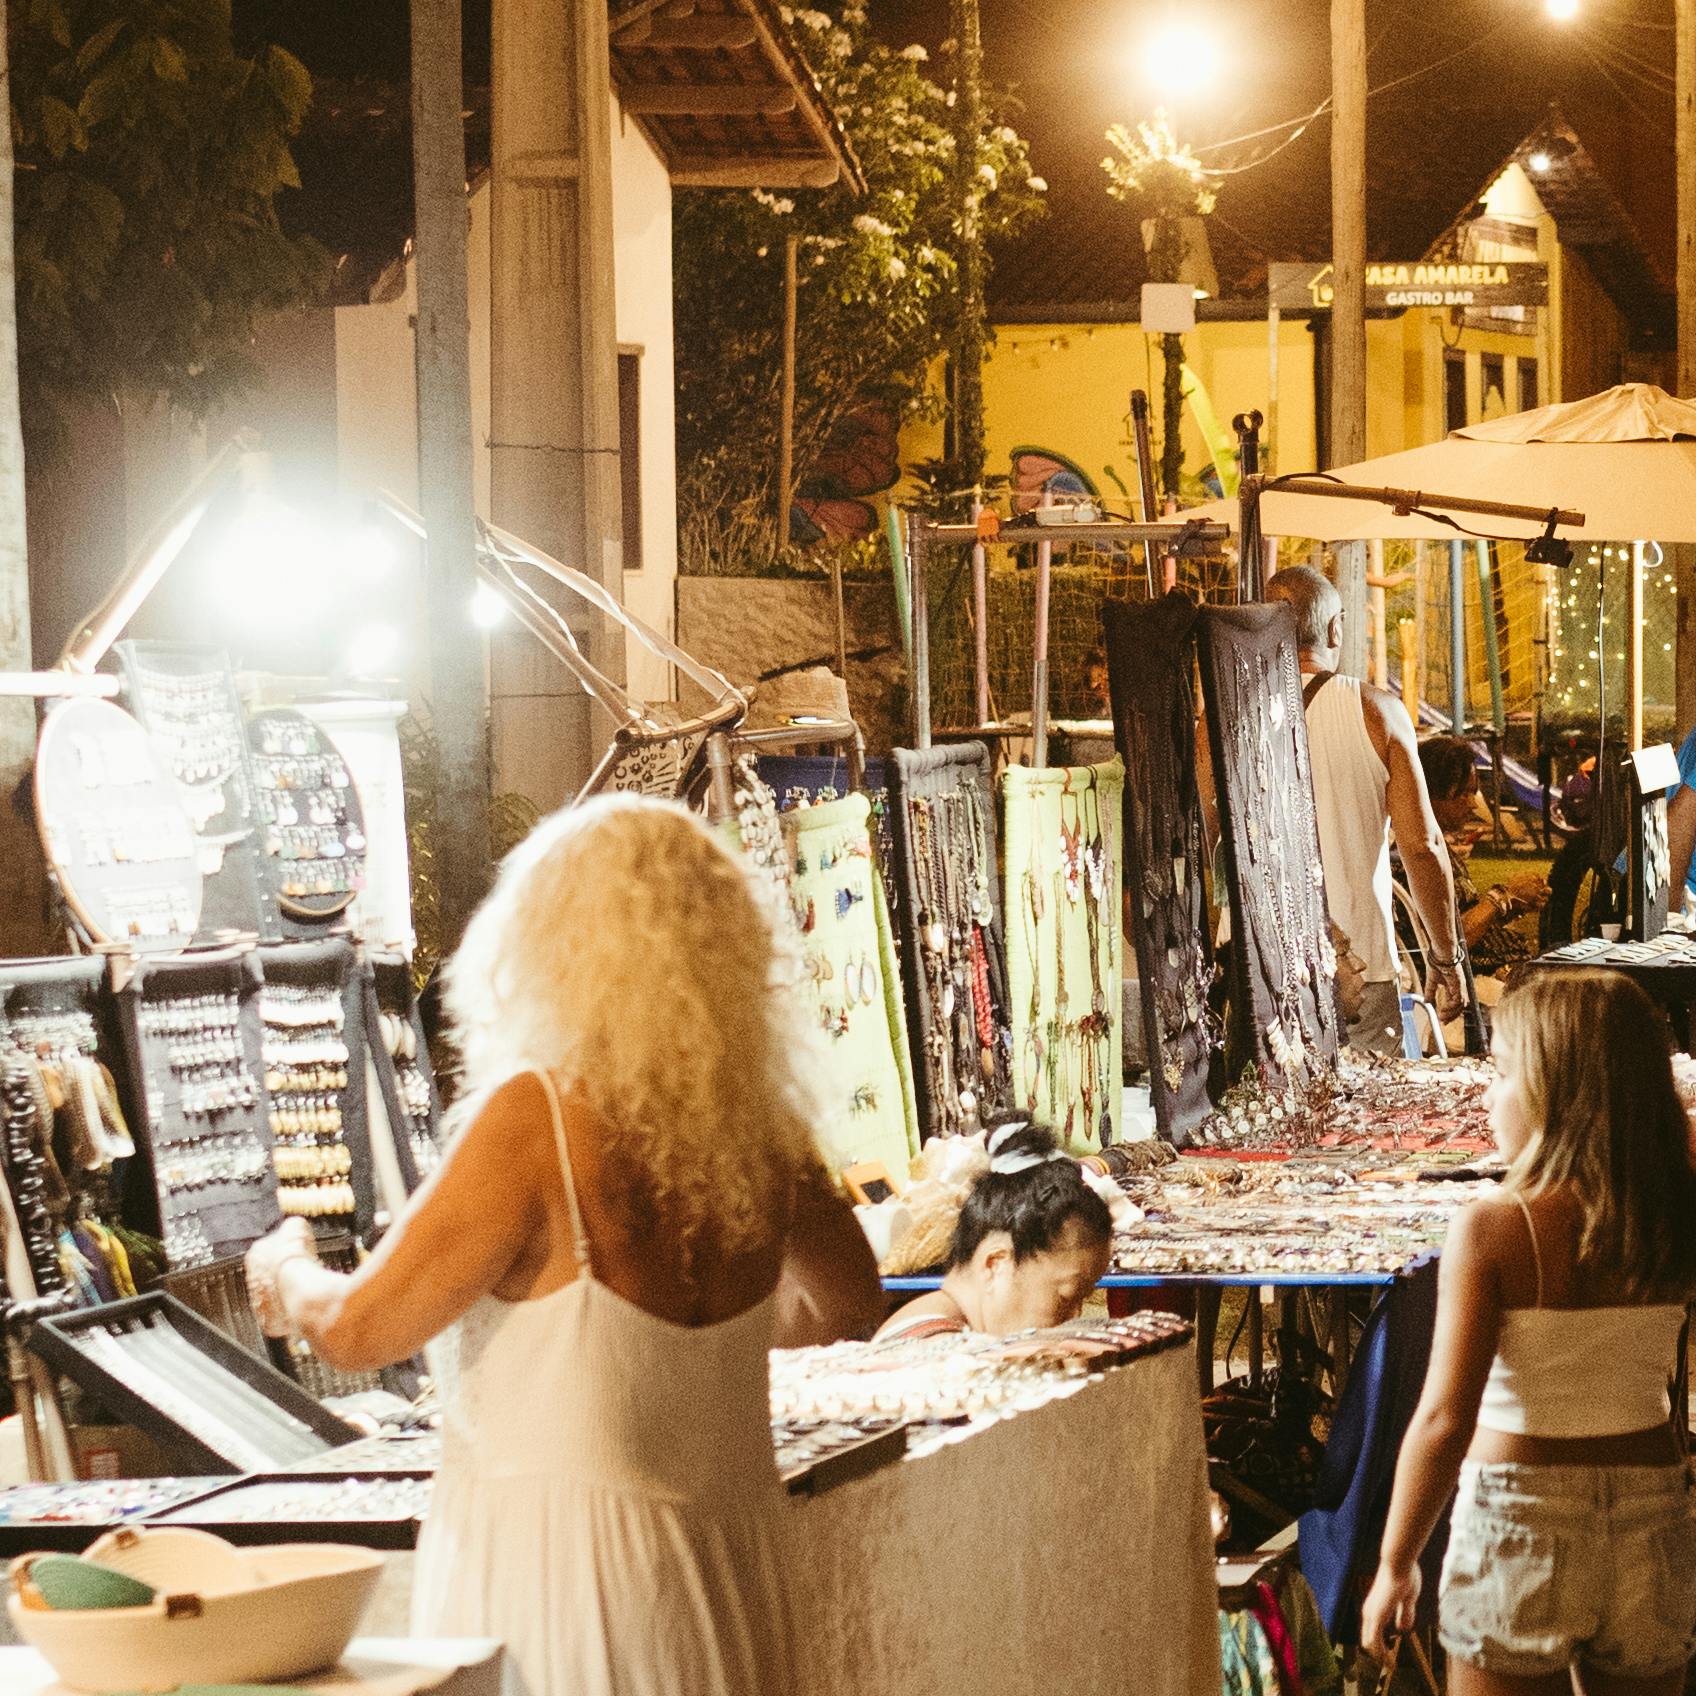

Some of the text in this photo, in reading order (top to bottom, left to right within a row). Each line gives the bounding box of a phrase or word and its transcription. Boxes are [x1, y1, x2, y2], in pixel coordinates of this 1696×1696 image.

[1413, 264, 1509, 286] AMARELA
[1386, 290, 1474, 306] GASTRO BAR
